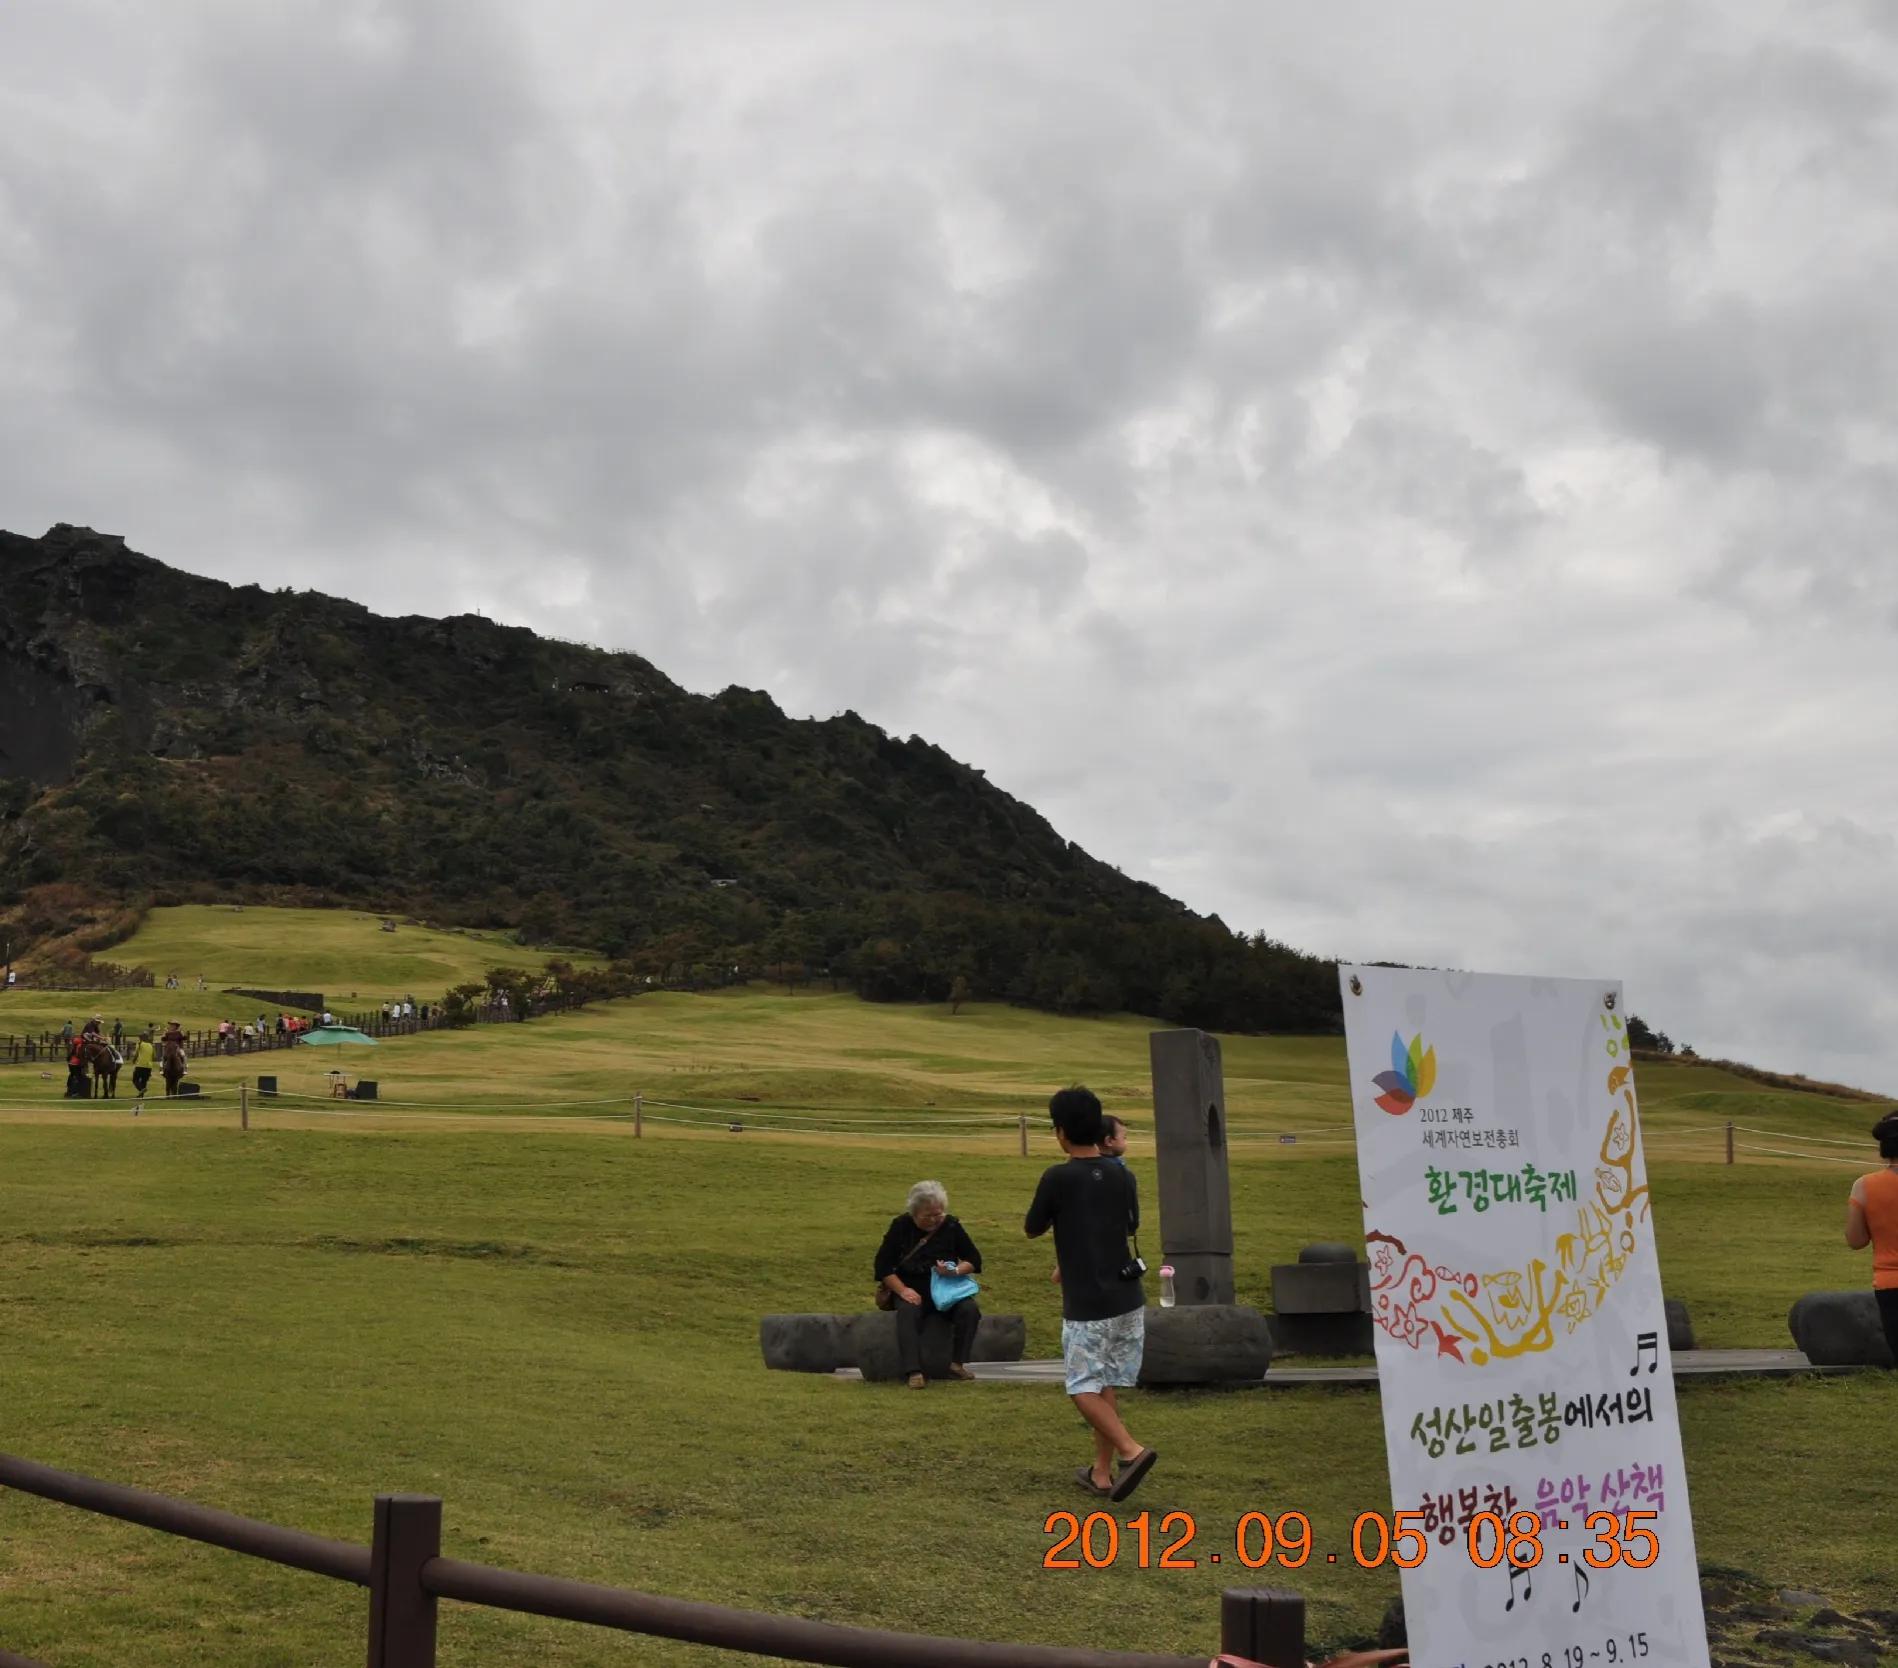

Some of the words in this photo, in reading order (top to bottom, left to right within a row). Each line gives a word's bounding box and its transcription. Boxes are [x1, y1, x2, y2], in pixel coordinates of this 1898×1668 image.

[1419, 1108, 1449, 1123] 2012
[1452, 1107, 1475, 1124] 제주
[1422, 1128, 1520, 1150] 세계자연보전총회
[1424, 1162, 1578, 1216] 환경대축제
[1410, 1386, 1654, 1460] 성산일출봉에서의
[1534, 1473, 1592, 1531] 음악
[1599, 1461, 1665, 1518] 산책
